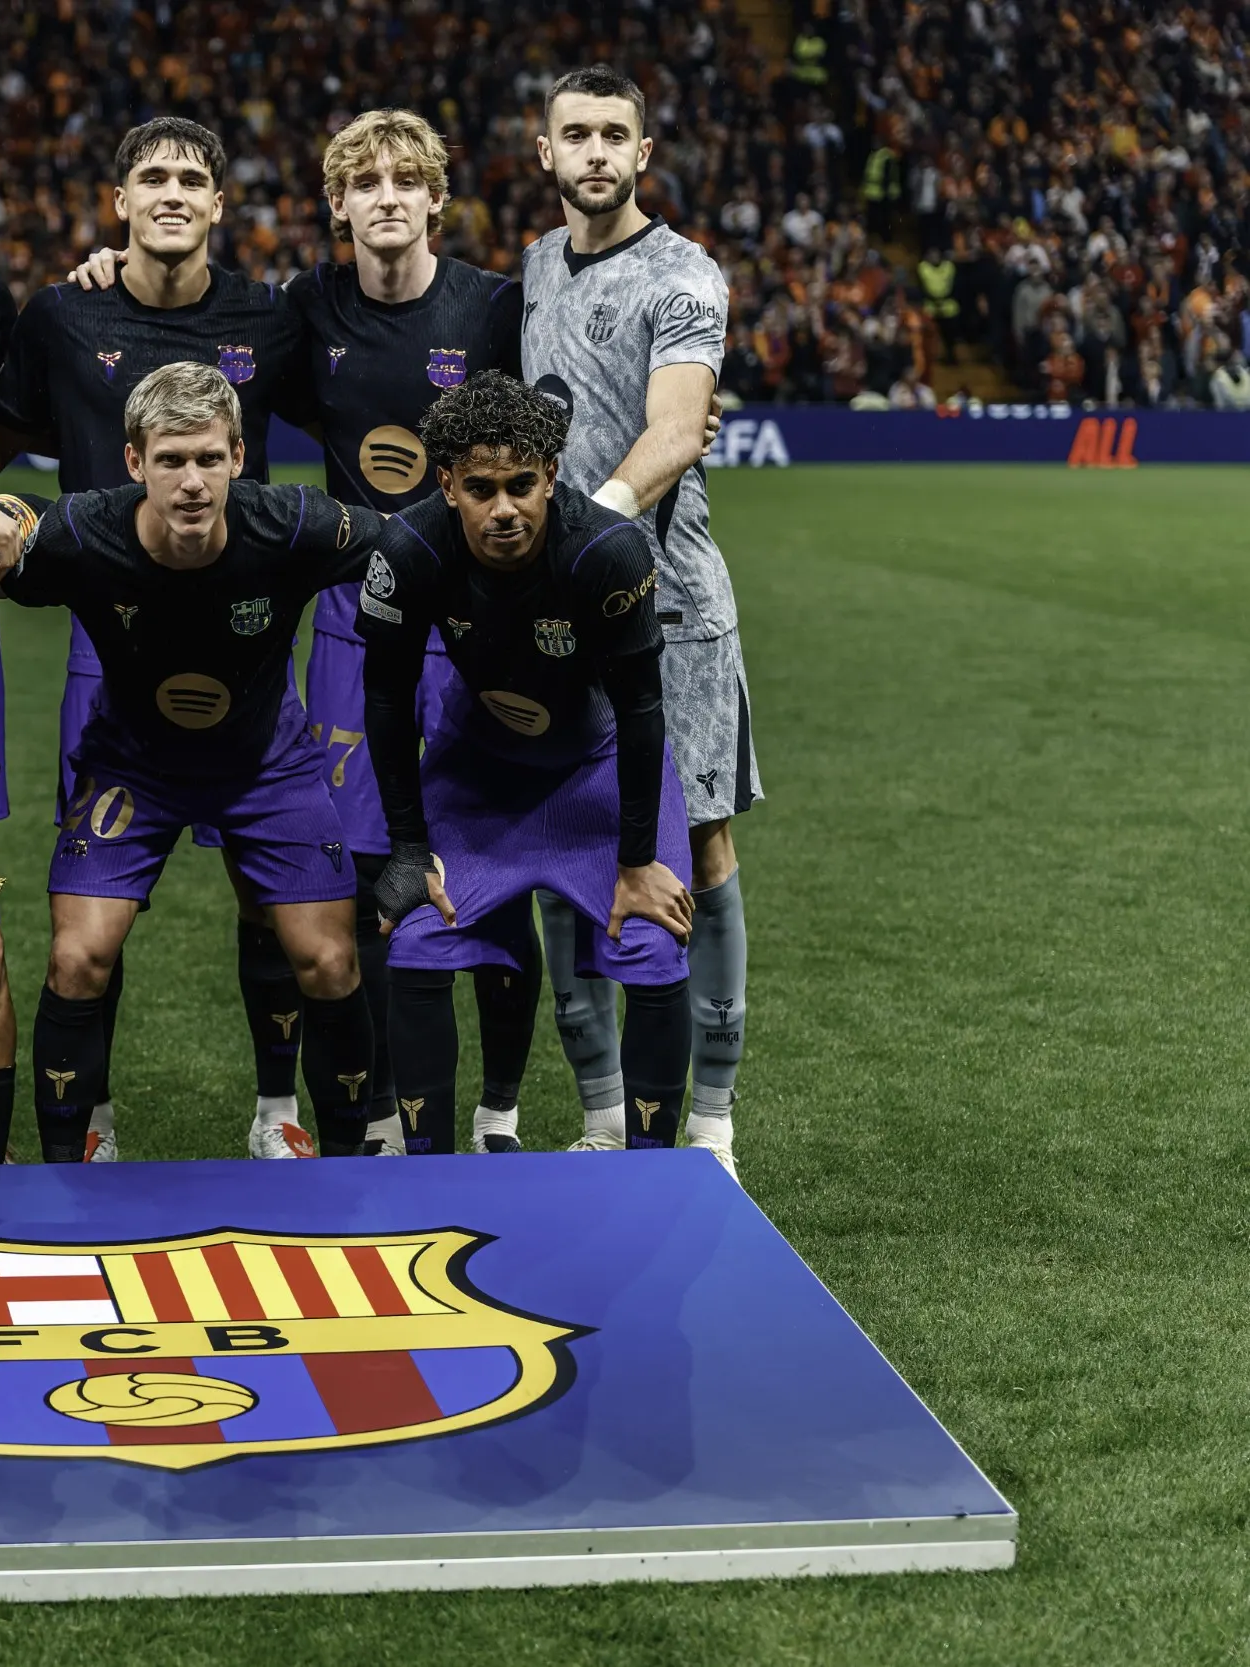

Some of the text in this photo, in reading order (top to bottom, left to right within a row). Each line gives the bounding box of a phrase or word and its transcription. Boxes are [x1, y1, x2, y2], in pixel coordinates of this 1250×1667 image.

[707, 419, 790, 468] EFA
[1067, 416, 1139, 469] ALL
[372, 566, 381, 583] 5
[61, 776, 134, 839] 20
